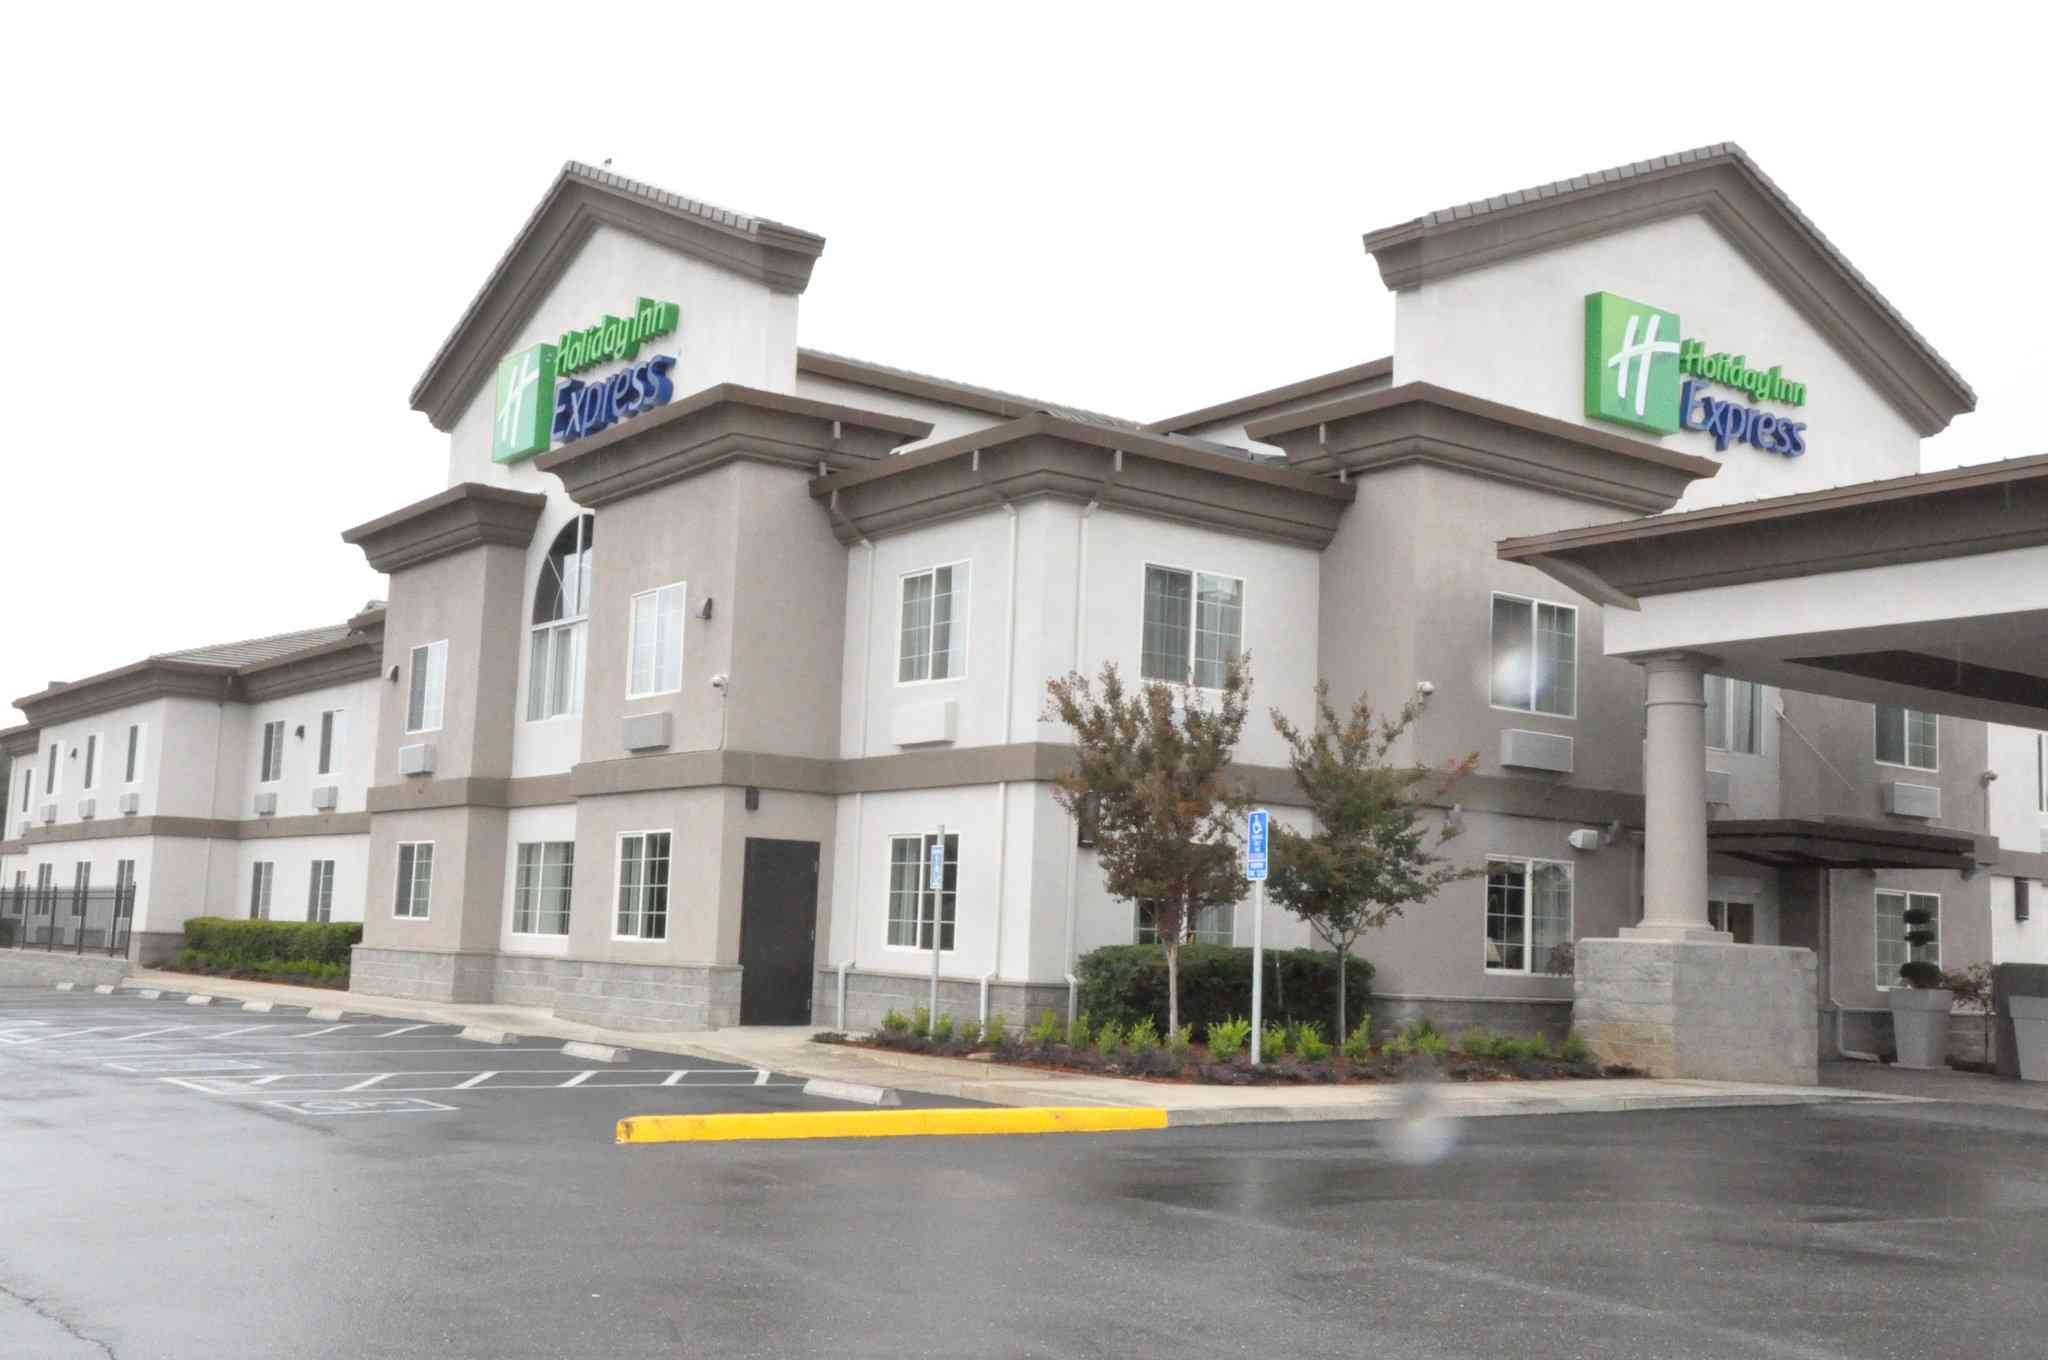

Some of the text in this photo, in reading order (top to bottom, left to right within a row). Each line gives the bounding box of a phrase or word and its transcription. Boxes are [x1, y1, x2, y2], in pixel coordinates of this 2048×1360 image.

[555, 298, 676, 377] Holiday Inn
[1681, 339, 1805, 406] Holiday Inn
[552, 355, 676, 442] Express
[1681, 380, 1806, 457] Express
